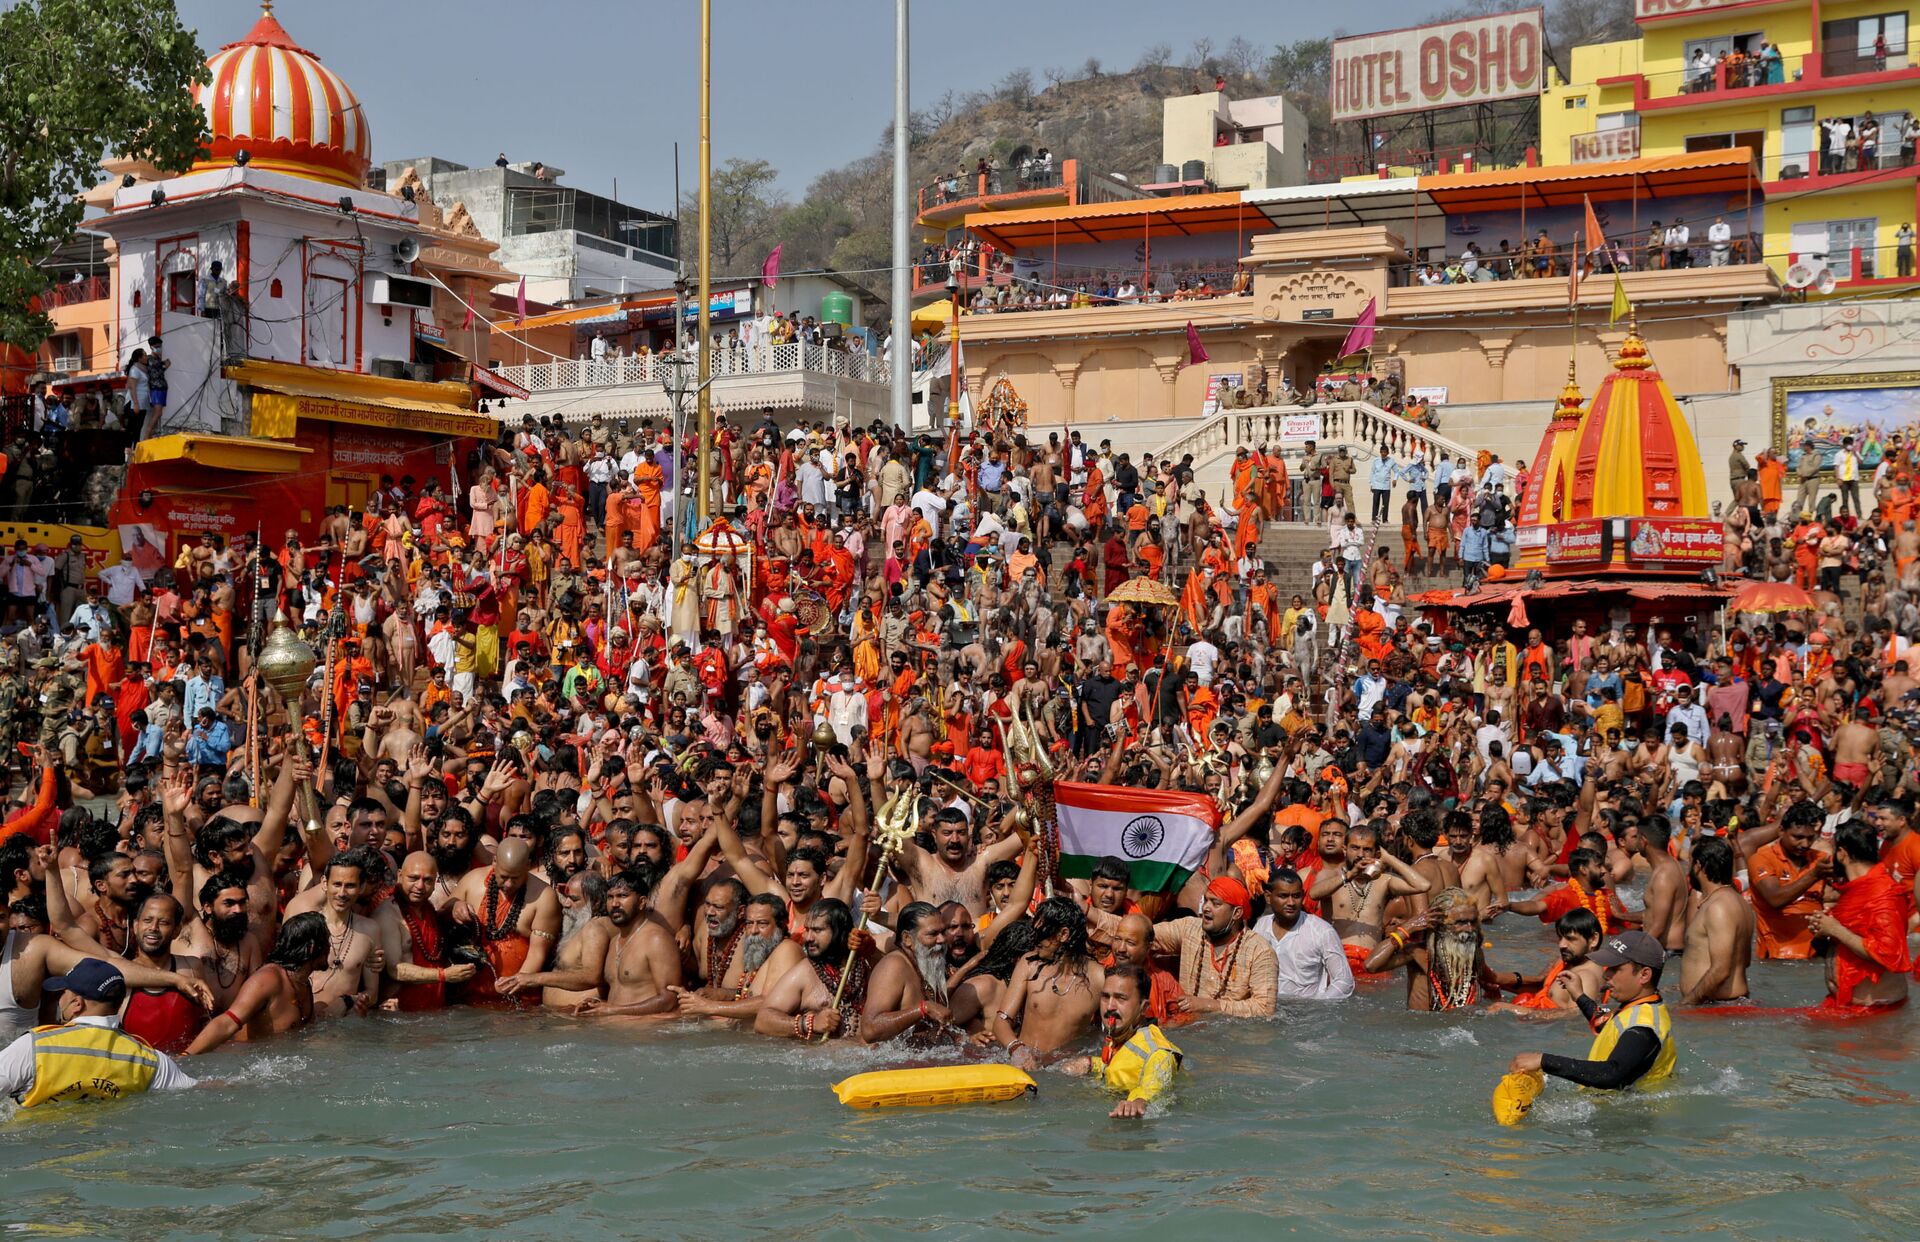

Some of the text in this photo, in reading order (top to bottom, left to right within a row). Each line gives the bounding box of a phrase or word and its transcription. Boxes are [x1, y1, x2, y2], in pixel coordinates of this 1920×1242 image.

[1334, 22, 1540, 113] HOTEL OSHO
[298, 399, 310, 414] श्री
[310, 401, 329, 416] गंगा
[340, 406, 357, 419] राजा
[456, 419, 485, 435] मन्दिर
[333, 450, 352, 463] राजा
[1662, 527, 1671, 543] श्री
[1671, 532, 1685, 543] राधा
[1686, 532, 1702, 548] कृष्ण
[92, 1077, 121, 1099] राहत
